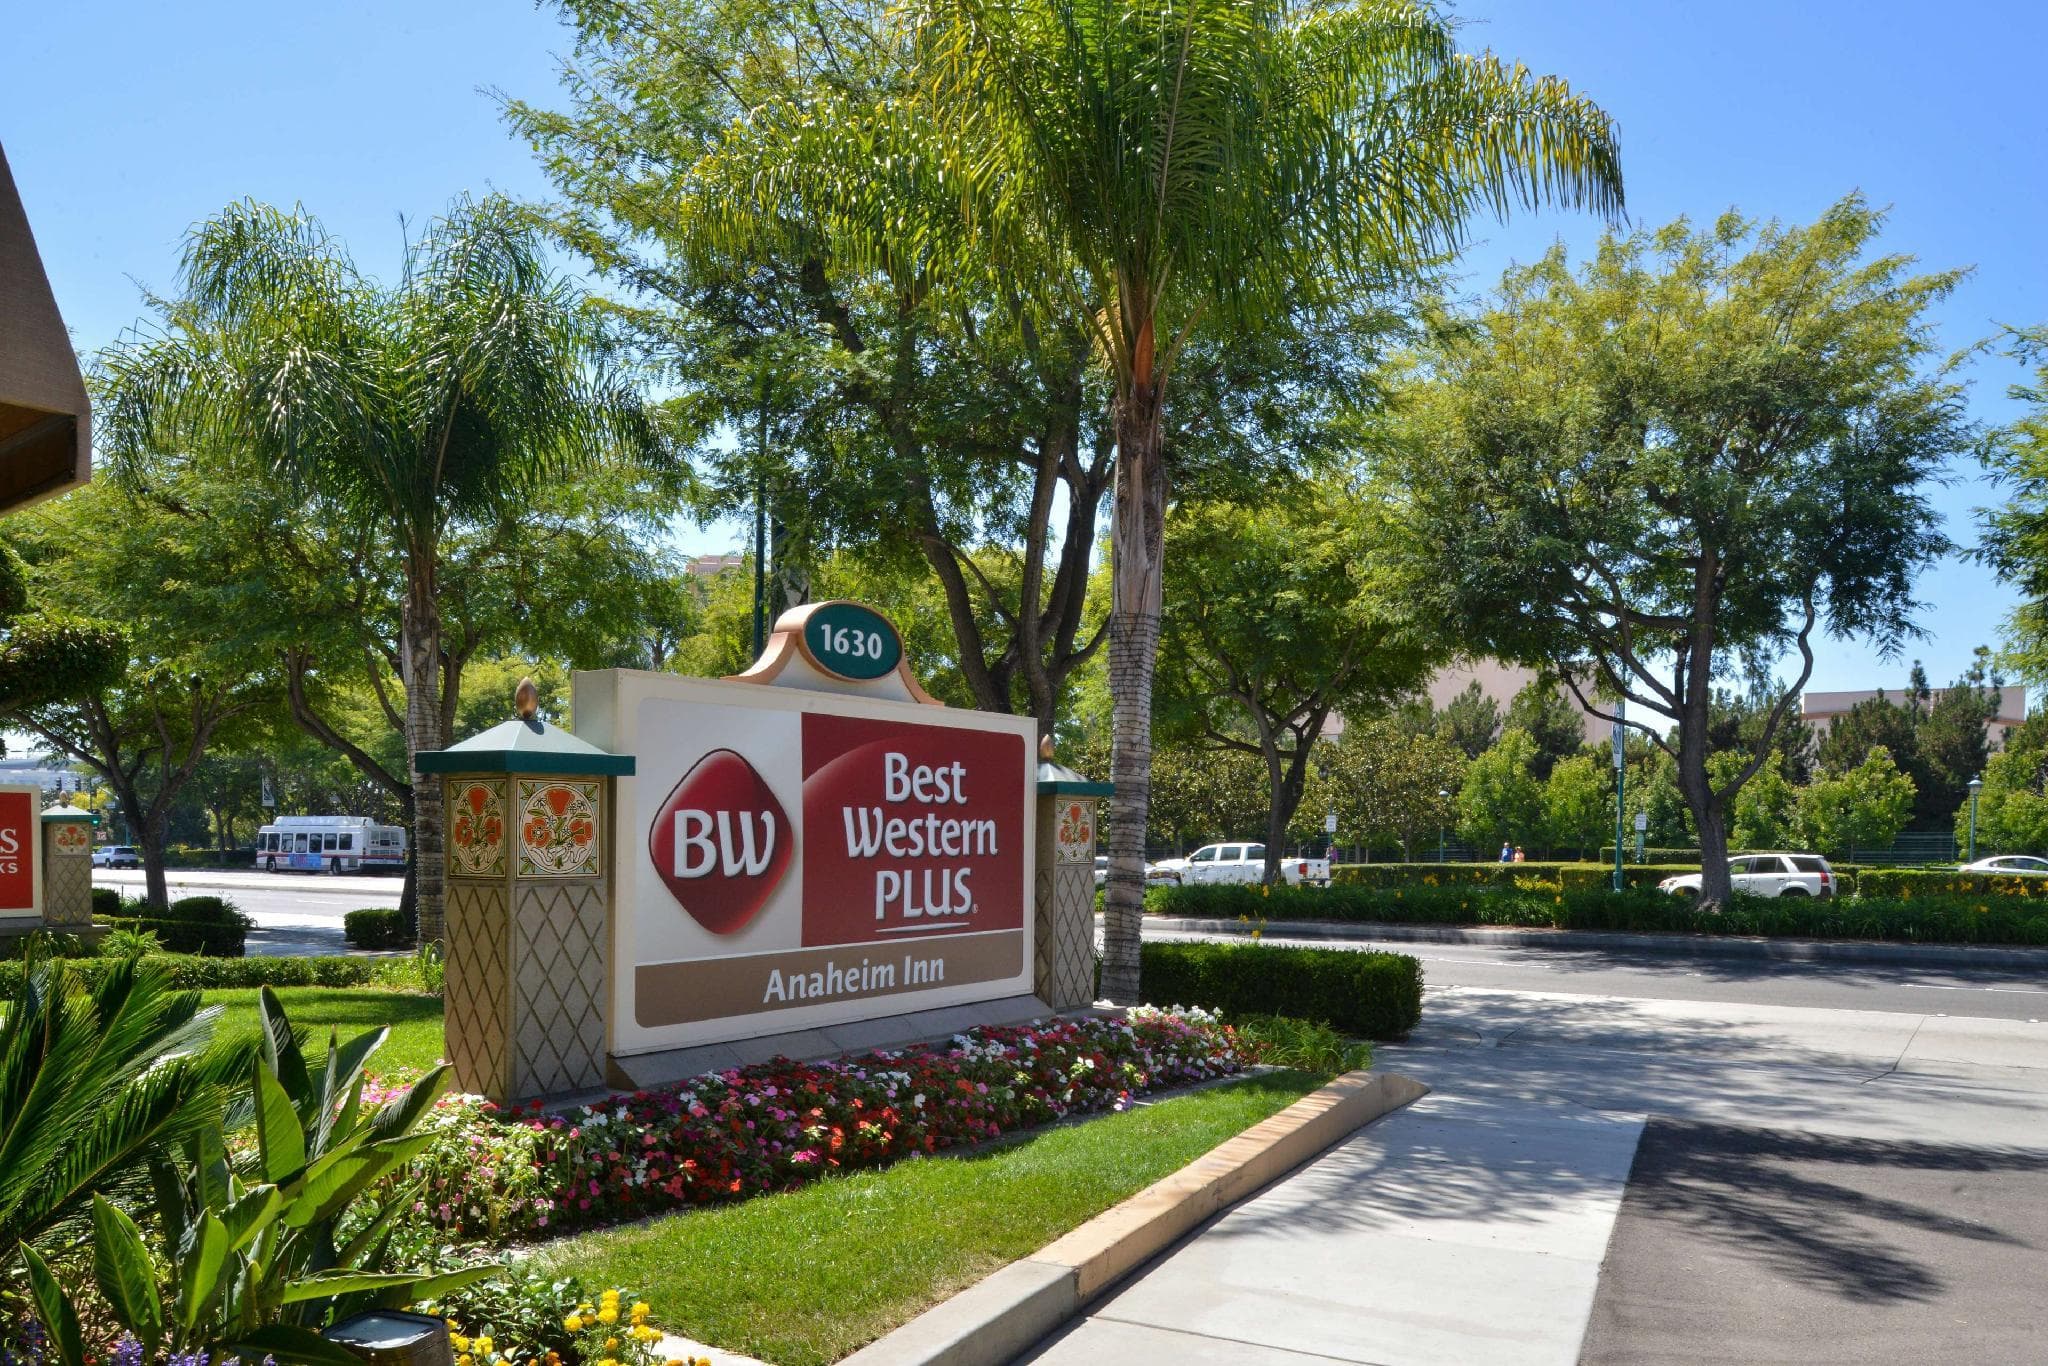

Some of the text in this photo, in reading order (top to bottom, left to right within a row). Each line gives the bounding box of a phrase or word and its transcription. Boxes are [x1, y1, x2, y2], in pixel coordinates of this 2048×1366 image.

[821, 623, 883, 660] 1630
[884, 751, 968, 804] Best
[673, 809, 776, 879] BW
[842, 806, 998, 858] Western
[875, 867, 972, 920] PLUS
[763, 955, 945, 1003] Anaheim Inn
